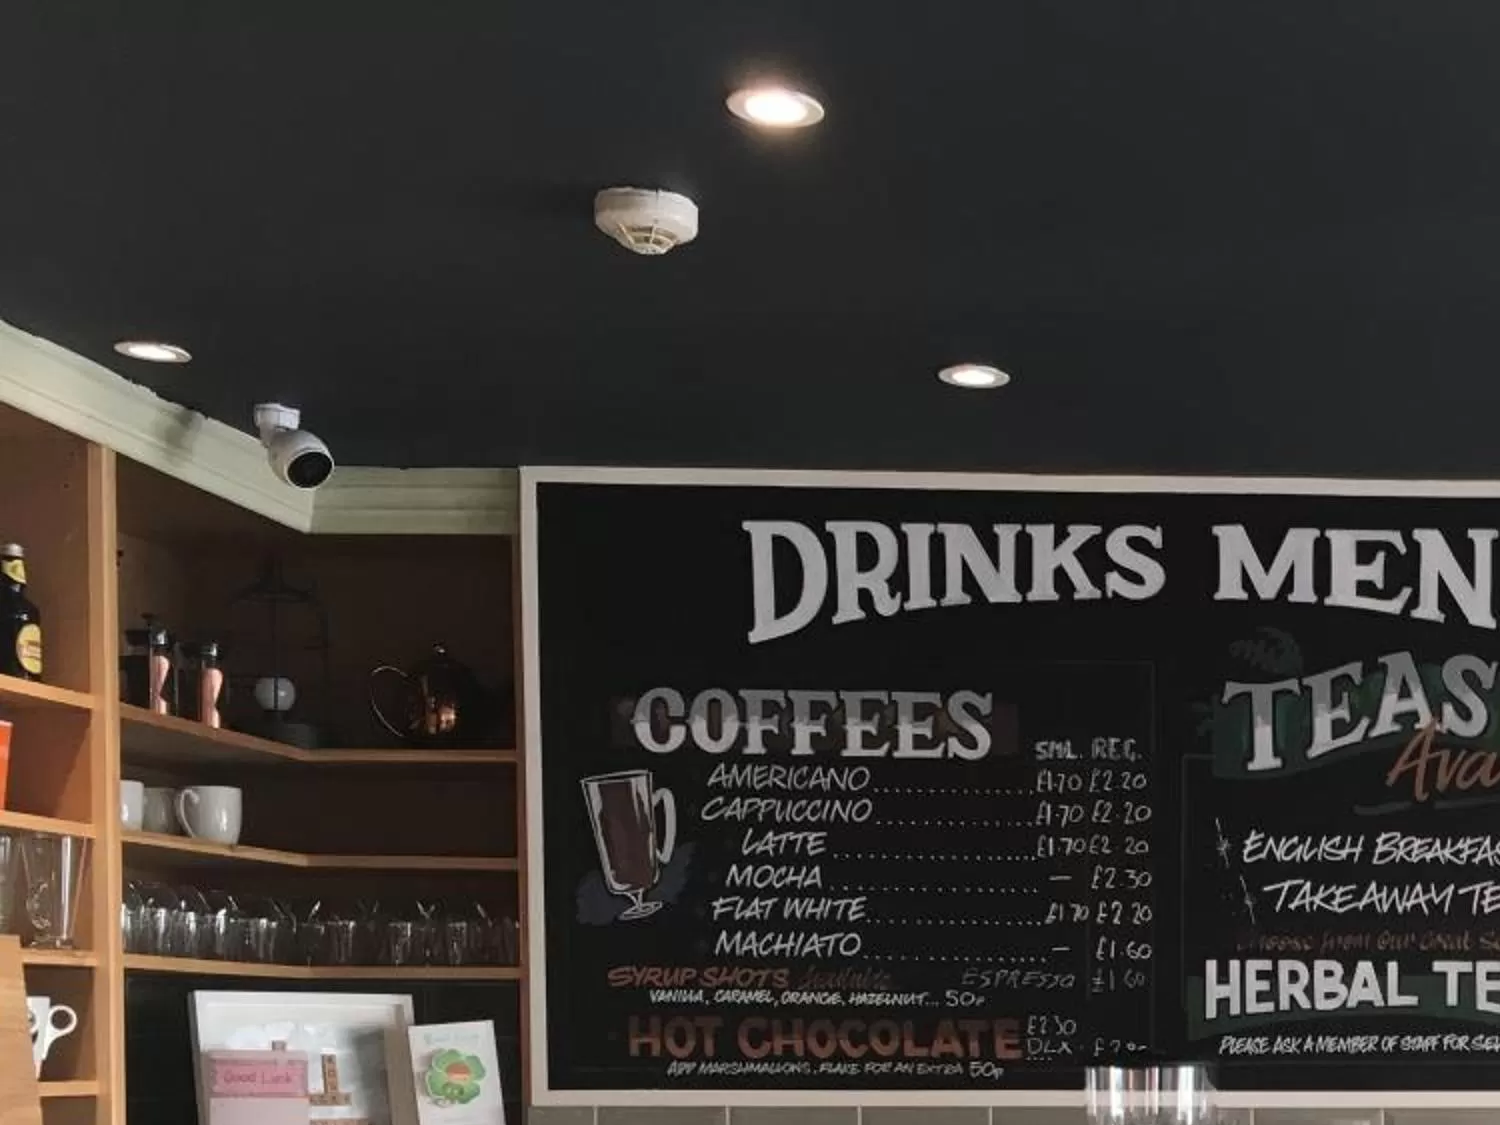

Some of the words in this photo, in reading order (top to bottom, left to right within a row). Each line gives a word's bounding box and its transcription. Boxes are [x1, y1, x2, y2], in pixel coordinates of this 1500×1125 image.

[742, 520, 1166, 644] DRINKS
[632, 687, 993, 760] COFFEES
[1221, 652, 1498, 771] TEAS
[708, 765, 870, 793] AMERICANO
[700, 798, 872, 824] CAPPUCCINO
[741, 831, 827, 857] LATTE
[1243, 830, 1364, 864] ENGLISH
[725, 865, 823, 890] MOCHA
[711, 898, 780, 923] FLAT
[781, 898, 866, 922] WHITE
[1263, 880, 1455, 917] TAKEAWAY
[714, 931, 862, 958] MACHIATO
[606, 965, 698, 989] SYRUP
[702, 965, 790, 989] SHOTS
[961, 966, 1077, 990] ESPRESSO
[1204, 959, 1420, 1020] HERBAL
[627, 1015, 724, 1059] HOT
[736, 1014, 1025, 1060] CHOCOLATE
[1218, 1035, 1270, 1056] PLEASE
[1272, 1036, 1301, 1056] ASK
[1303, 1036, 1314, 1054] A
[1315, 1035, 1379, 1055] MEMBER
[1381, 1035, 1400, 1054] OF
[1401, 1034, 1441, 1053] STAFF
[1442, 1034, 1470, 1053] FOR
